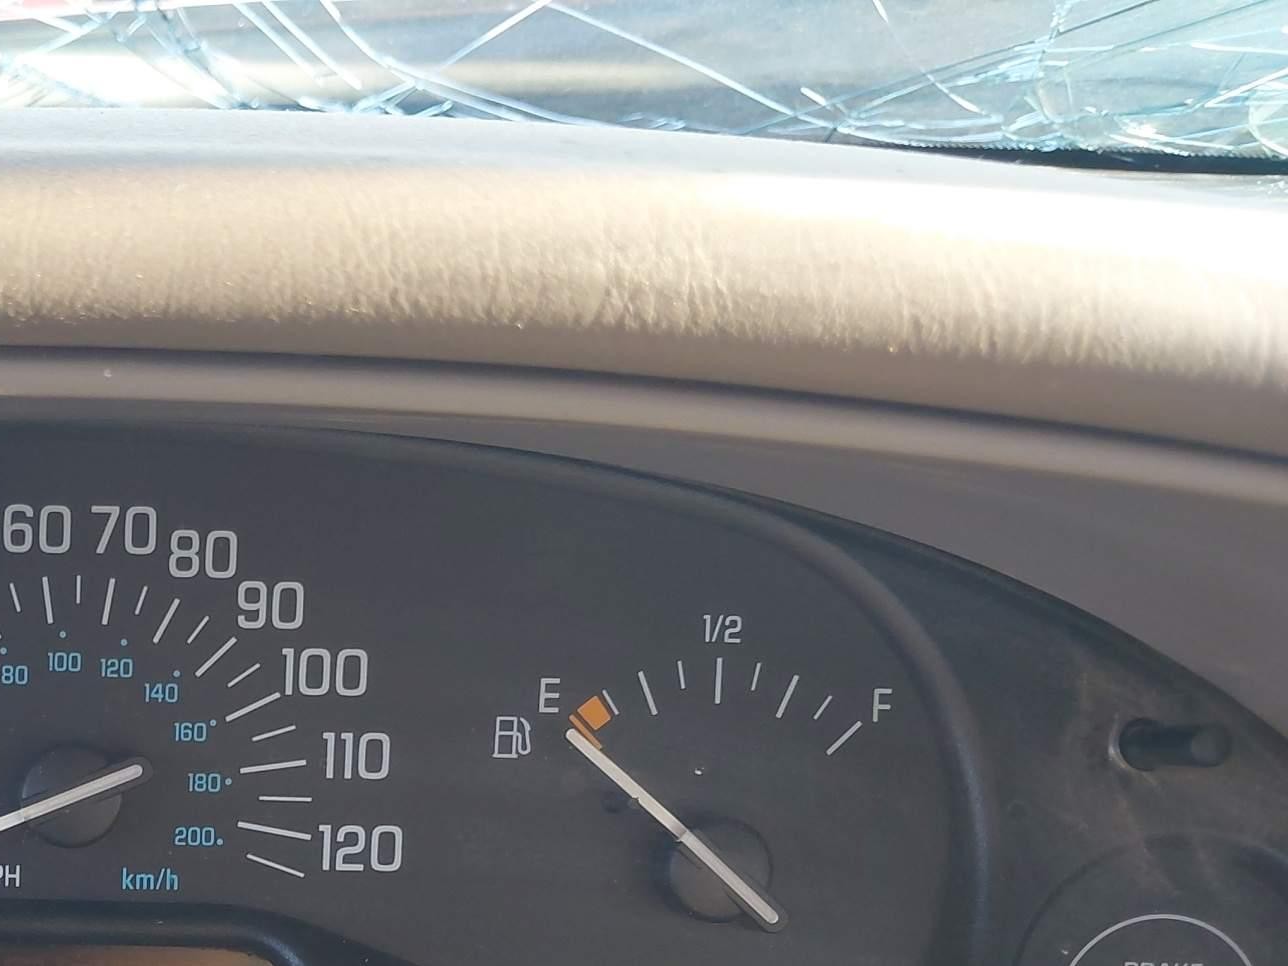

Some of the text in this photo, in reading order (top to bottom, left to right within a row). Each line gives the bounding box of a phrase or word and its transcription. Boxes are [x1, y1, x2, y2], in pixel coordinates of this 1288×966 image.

[4, 504, 71, 553] 60
[92, 506, 156, 554] 70
[169, 530, 237, 578] 80
[238, 581, 304, 629] 90
[704, 615, 741, 643] 1/2
[2, 666, 27, 684] 80
[48, 653, 81, 671] 100
[101, 659, 132, 677] 120
[282, 648, 368, 693] 100
[145, 684, 178, 702] 140
[539, 678, 560, 712] E
[873, 689, 892, 721] F
[175, 723, 206, 741] 160
[323, 732, 390, 779] 110
[189, 774, 220, 792] 180
[175, 827, 214, 845] 200
[319, 825, 402, 871] 120
[123, 868, 178, 890] km/h
